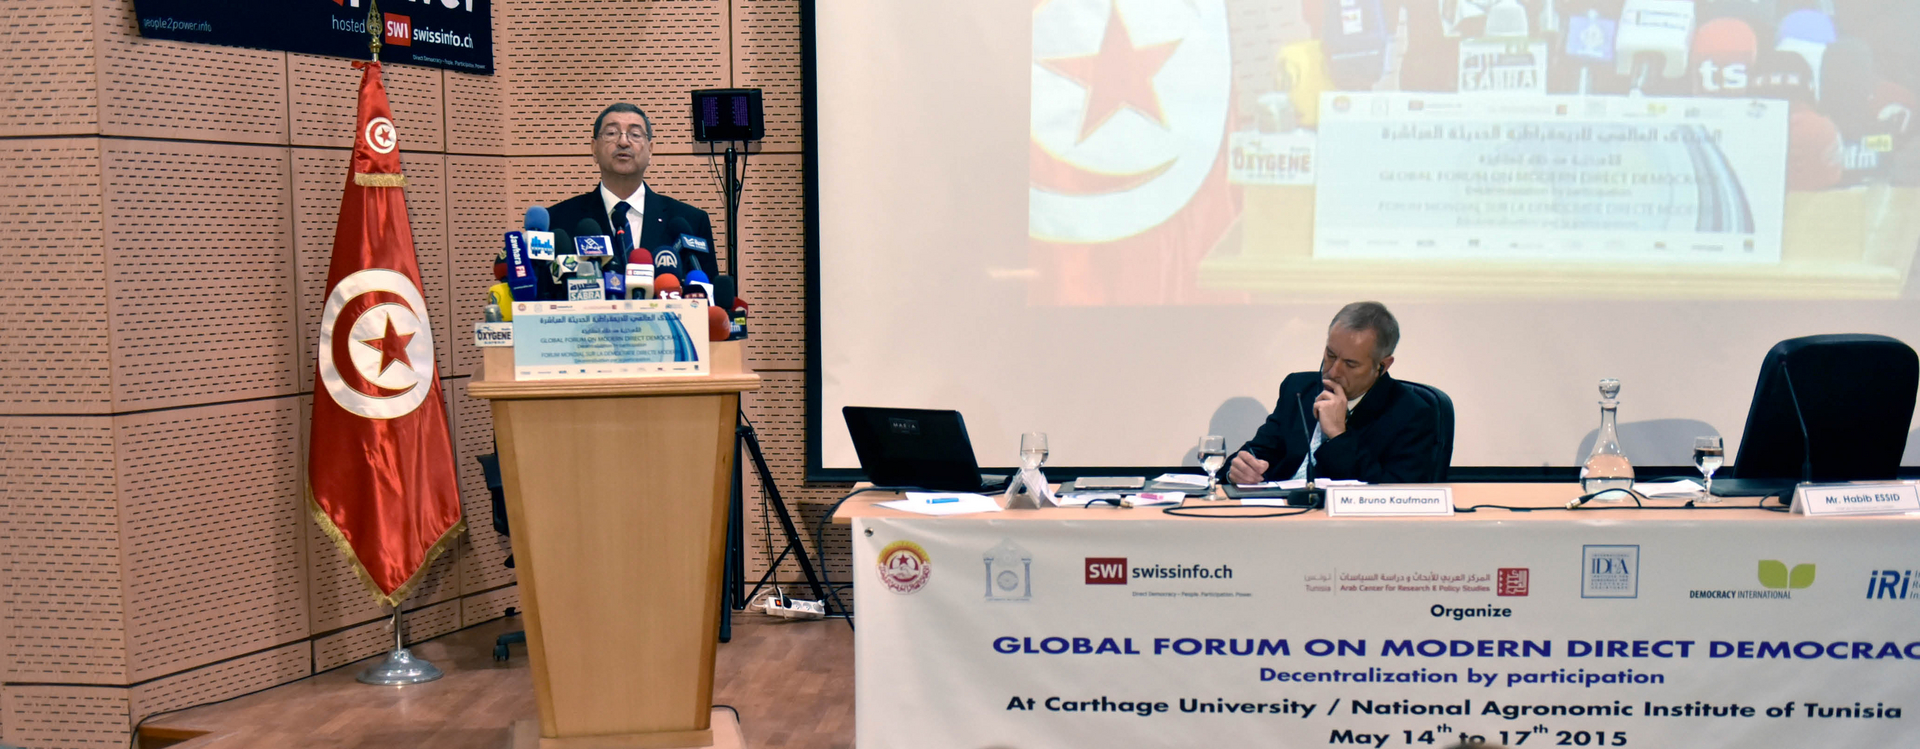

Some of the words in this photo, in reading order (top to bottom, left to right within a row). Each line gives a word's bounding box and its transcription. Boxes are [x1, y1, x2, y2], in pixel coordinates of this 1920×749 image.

[332, 14, 366, 34] hosted
[387, 20, 409, 39] SWI
[413, 26, 474, 49] swissinfo.ch
[1699, 59, 1748, 91] ts
[1232, 146, 1311, 173] OXYGENE
[656, 255, 677, 268] AA
[569, 291, 602, 300] SABRA
[477, 330, 512, 341] OXYGENE
[1360, 496, 1386, 504] Bruno
[1389, 496, 1440, 504] Kaufmann
[1825, 496, 1841, 504] Mr.
[1843, 494, 1872, 503] Habib
[1875, 493, 1900, 502] ESSID
[1089, 563, 1123, 579] SWI
[1132, 563, 1233, 579] swissinfo.ch
[1340, 584, 1357, 592] Arab
[1359, 584, 1384, 592] Center
[1385, 584, 1396, 592] for
[1398, 584, 1430, 592] Research
[1439, 584, 1460, 594] Policy
[1462, 584, 1491, 592] Studies
[1689, 590, 1736, 599] DEMOCRACY
[1737, 590, 1792, 600] INTERNATIONAL
[1431, 603, 1512, 620] Organize
[992, 636, 1141, 655] GLOBAL
[1153, 637, 1291, 657] FORUM
[1304, 638, 1367, 657] ON
[1380, 639, 1552, 658] MODERN
[1567, 639, 1696, 659] DIRECT
[1709, 640, 1920, 660] DEMOCRAC
[1259, 667, 1458, 684] Decentralization
[1467, 667, 1499, 688] by
[1506, 668, 1665, 688] participation
[1006, 696, 1036, 711] At
[1044, 696, 1170, 717] Carthage
[1179, 697, 1317, 719] University
[1326, 698, 1341, 716] /
[1351, 699, 1471, 716] National
[1480, 699, 1633, 720] Agronomic
[1644, 701, 1756, 718] Institute
[1765, 701, 1796, 718] of
[1803, 701, 1902, 719] Tunisia
[1329, 729, 1390, 748] May
[1458, 731, 1486, 746] to
[1555, 730, 1628, 746] 2015
